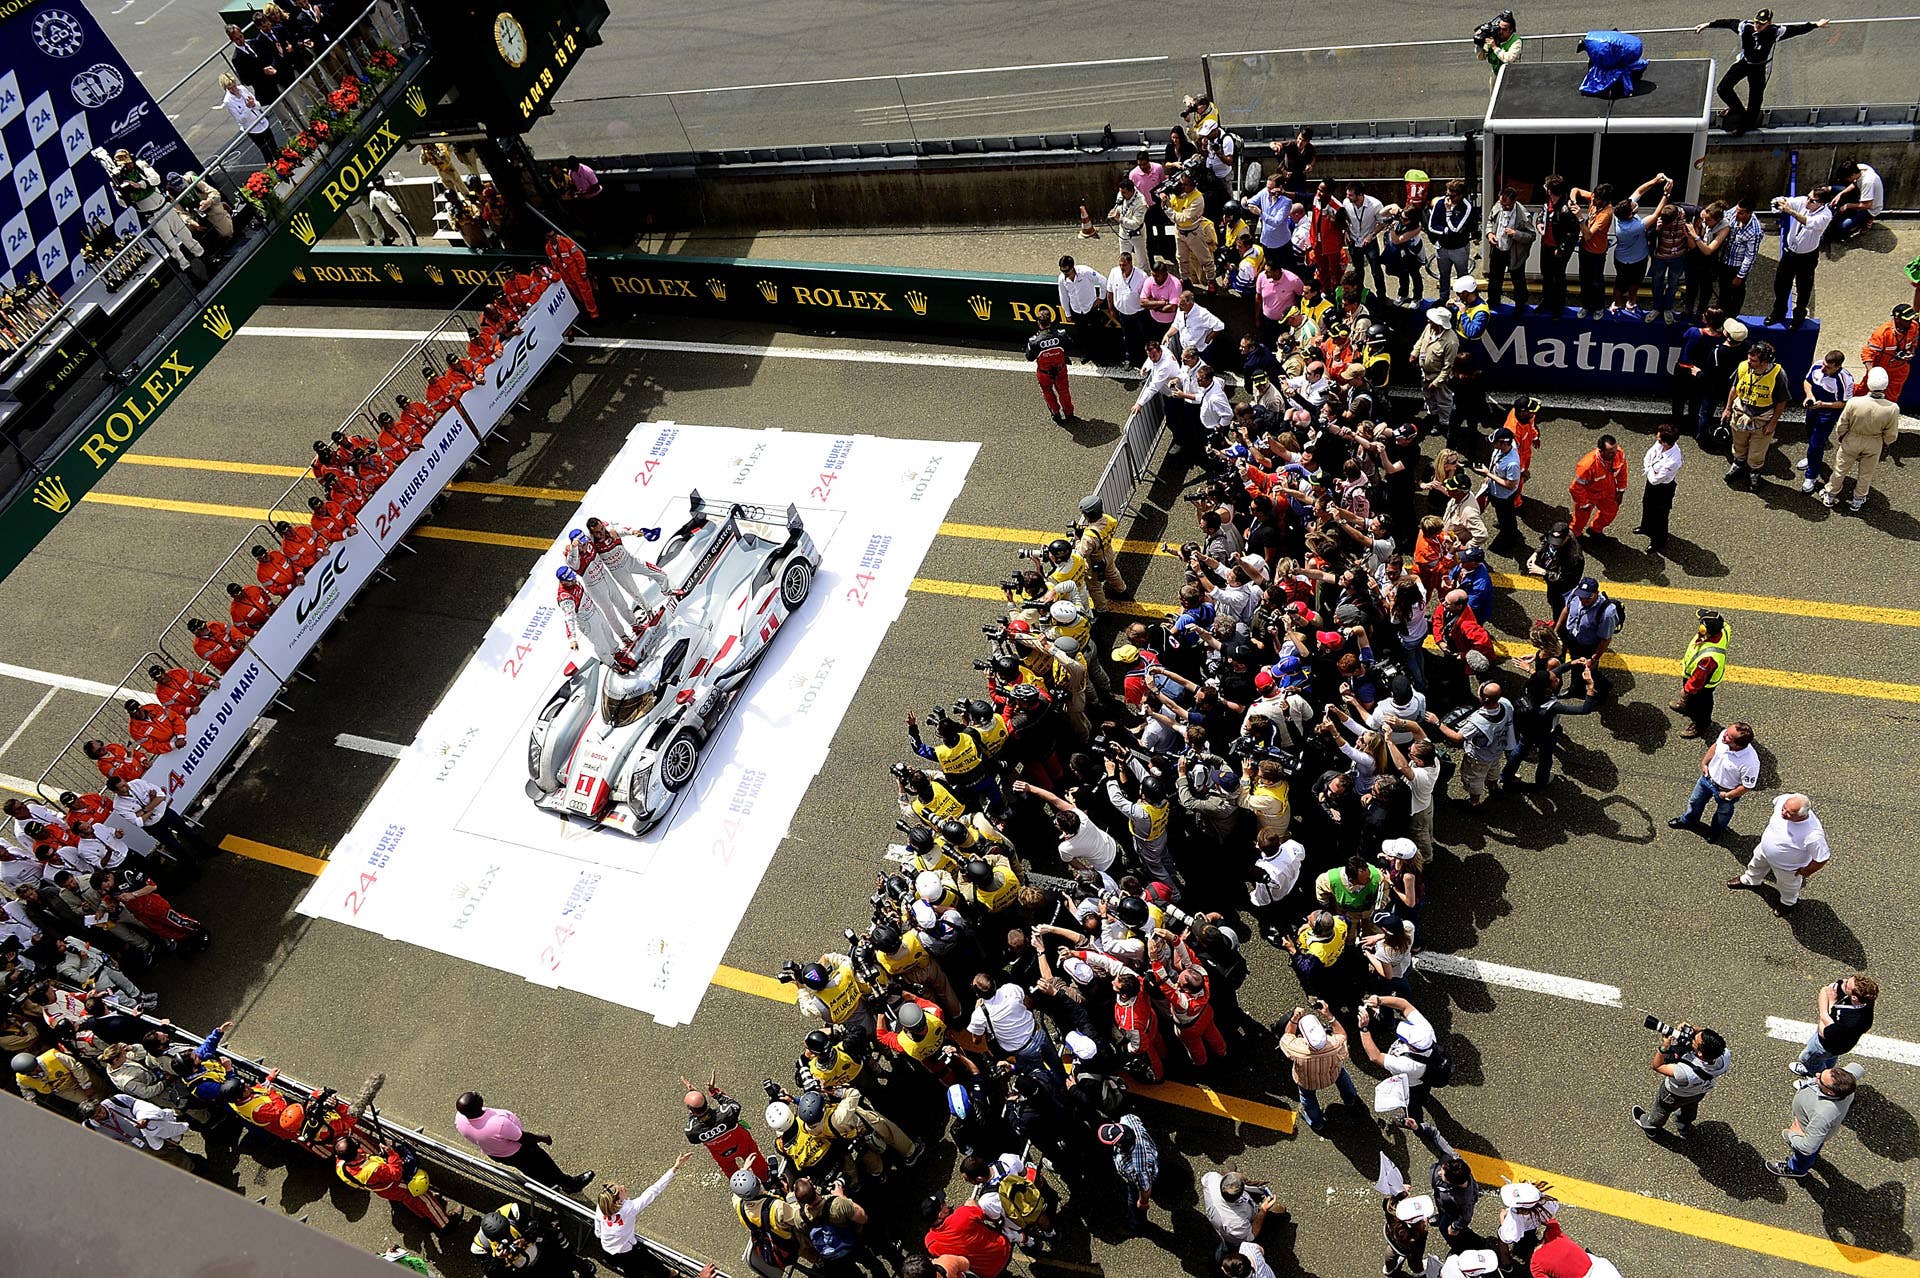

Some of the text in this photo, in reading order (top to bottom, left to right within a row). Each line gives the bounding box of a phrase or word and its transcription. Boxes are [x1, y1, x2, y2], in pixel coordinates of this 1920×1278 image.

[0, 0, 31, 18] ROL
[520, 34, 577, 118] 24 04 39 19 12
[32, 108, 51, 132] 24
[111, 101, 149, 134] WEC
[66, 128, 85, 151] 24
[19, 168, 39, 192] 24
[321, 119, 401, 213] ROLEX
[55, 186, 74, 210] 24
[88, 204, 106, 226] 24
[7, 227, 28, 251] 24
[42, 245, 61, 269] 24
[151, 277, 160, 289] 3
[312, 266, 381, 283] ROLEX
[451, 269, 506, 286] ROLE
[610, 276, 698, 298] ROLEX
[547, 287, 567, 316] MANS
[791, 285, 893, 311] ROLEX
[1009, 301, 1123, 329] ROLX
[496, 325, 538, 390] WEC
[80, 350, 194, 469] ROLEX
[650, 428, 672, 456] HEURES
[824, 439, 845, 469] HEURES
[835, 440, 854, 470] DU MANS
[375, 419, 464, 541] 24 HEURES DU MANS
[634, 458, 661, 487] 24
[733, 442, 767, 485] ROLEX
[910, 456, 943, 501] ROLEX
[811, 472, 838, 503] 24
[682, 524, 733, 594] udi e-tron quattro
[860, 534, 882, 568] HEURES
[872, 535, 892, 570] DU MANS
[296, 545, 349, 625] WEC
[846, 571, 876, 607] 24
[296, 619, 312, 638] WORLD
[311, 586, 338, 620] ENDURANCE
[522, 605, 548, 640] HEURES
[532, 607, 556, 641] DU MANS
[763, 622, 776, 638] 1
[503, 643, 533, 679] 24
[797, 657, 836, 715] ROLEX
[182, 723, 220, 776] HEURES
[215, 704, 234, 727] DU
[232, 662, 260, 705] MANS
[436, 728, 480, 781] ROLEX
[576, 776, 591, 796] 1
[729, 768, 756, 813] HEURES
[741, 771, 767, 816] DU MANS
[368, 823, 399, 866] HEURES
[378, 826, 406, 869] DU MANS
[344, 871, 378, 915] 24
[453, 864, 501, 930] ROLEX
